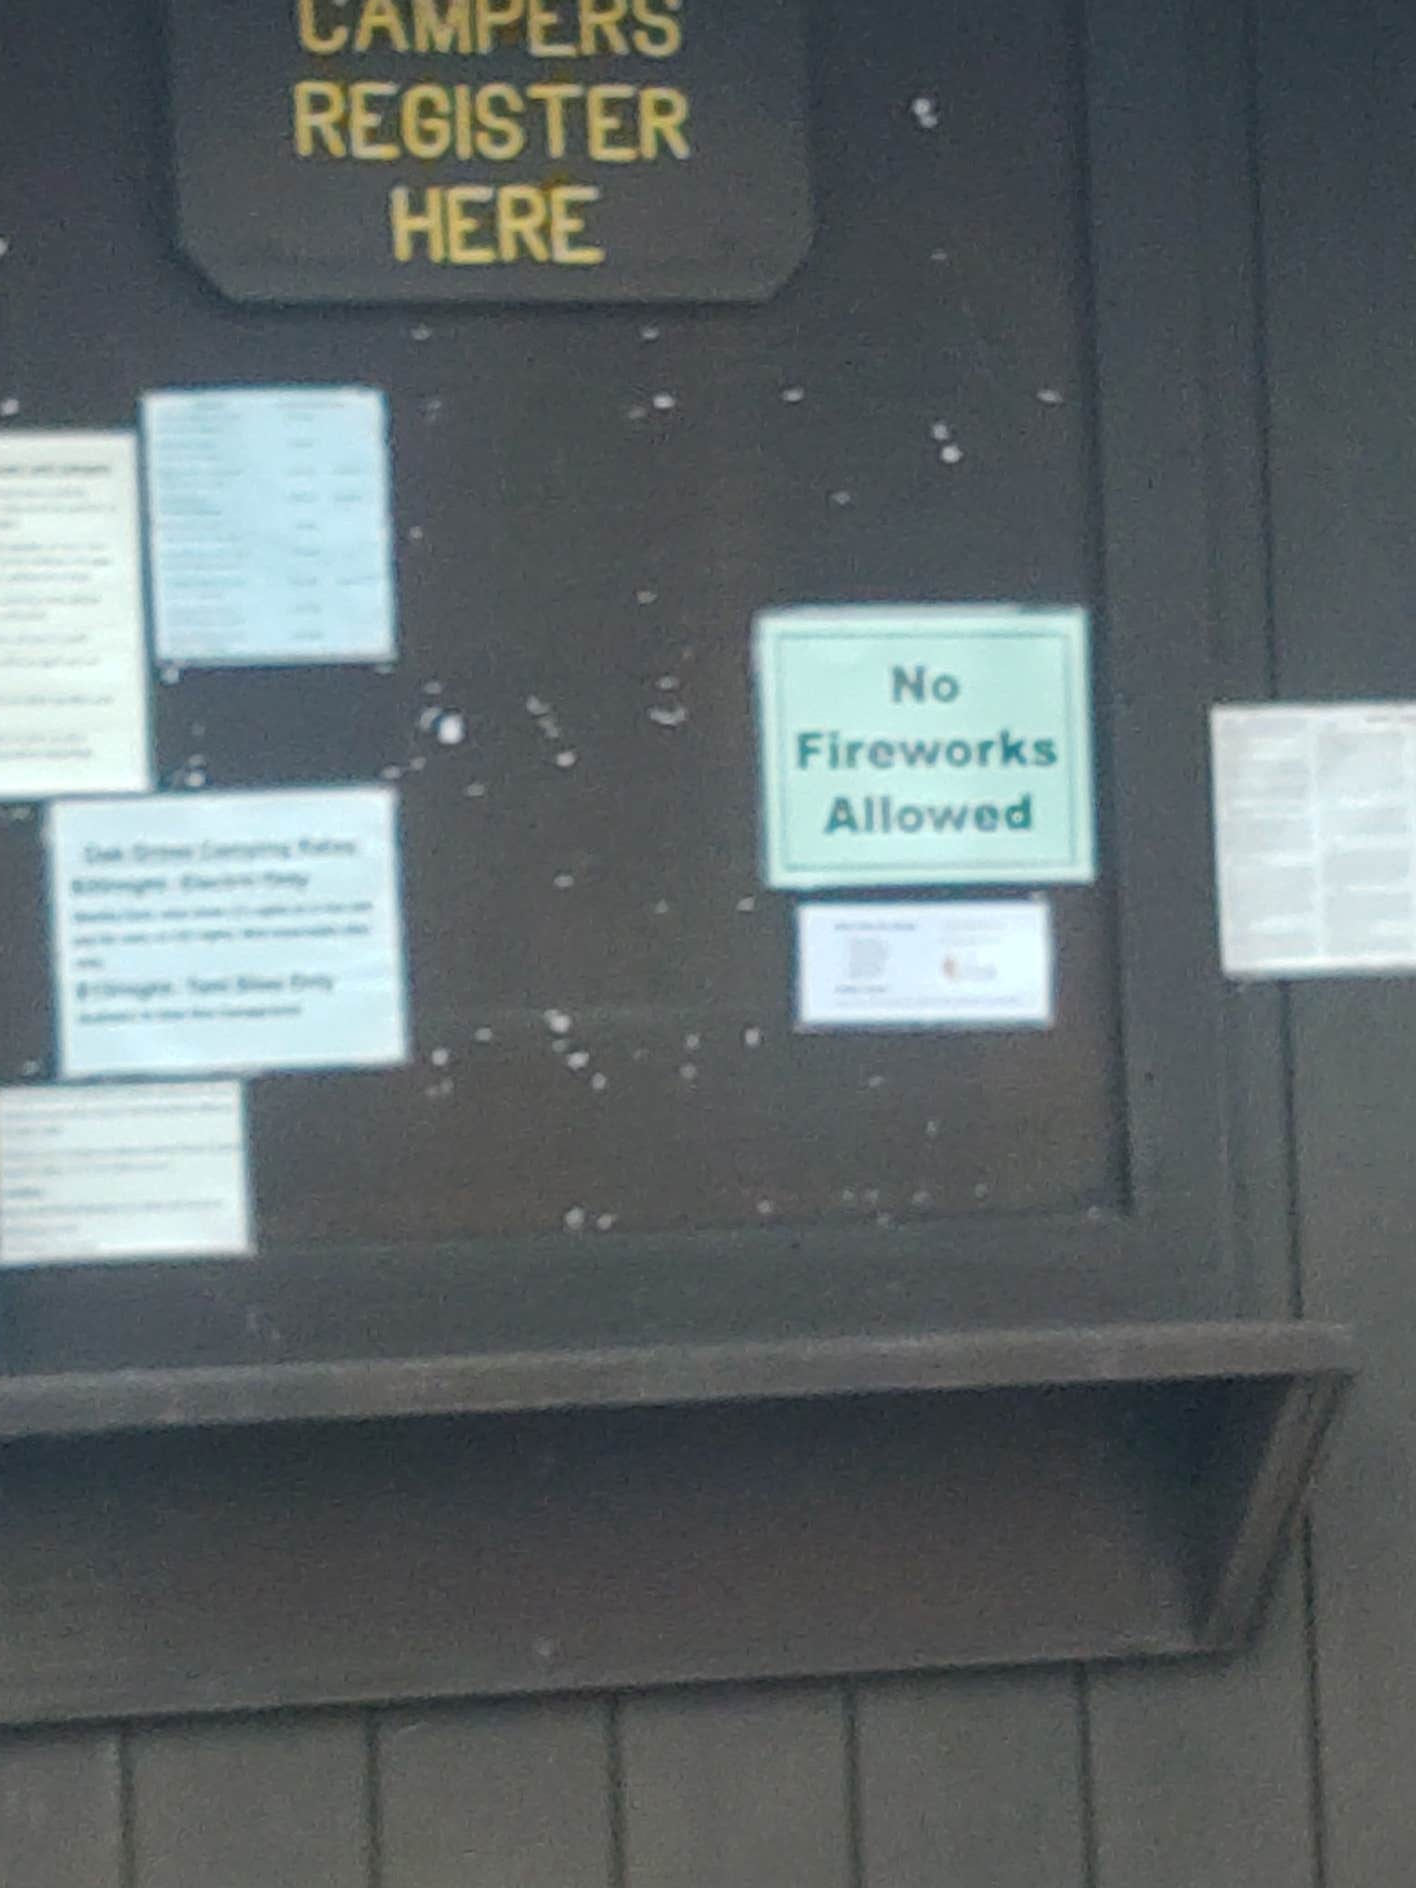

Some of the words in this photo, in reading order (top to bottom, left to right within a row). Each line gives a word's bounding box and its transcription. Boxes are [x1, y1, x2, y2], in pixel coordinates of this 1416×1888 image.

[292, 79, 692, 162] REGISTER
[386, 184, 606, 265] HERE
[890, 665, 961, 705] No
[795, 730, 1058, 771] Fireworks
[822, 795, 1033, 835] Allowed
